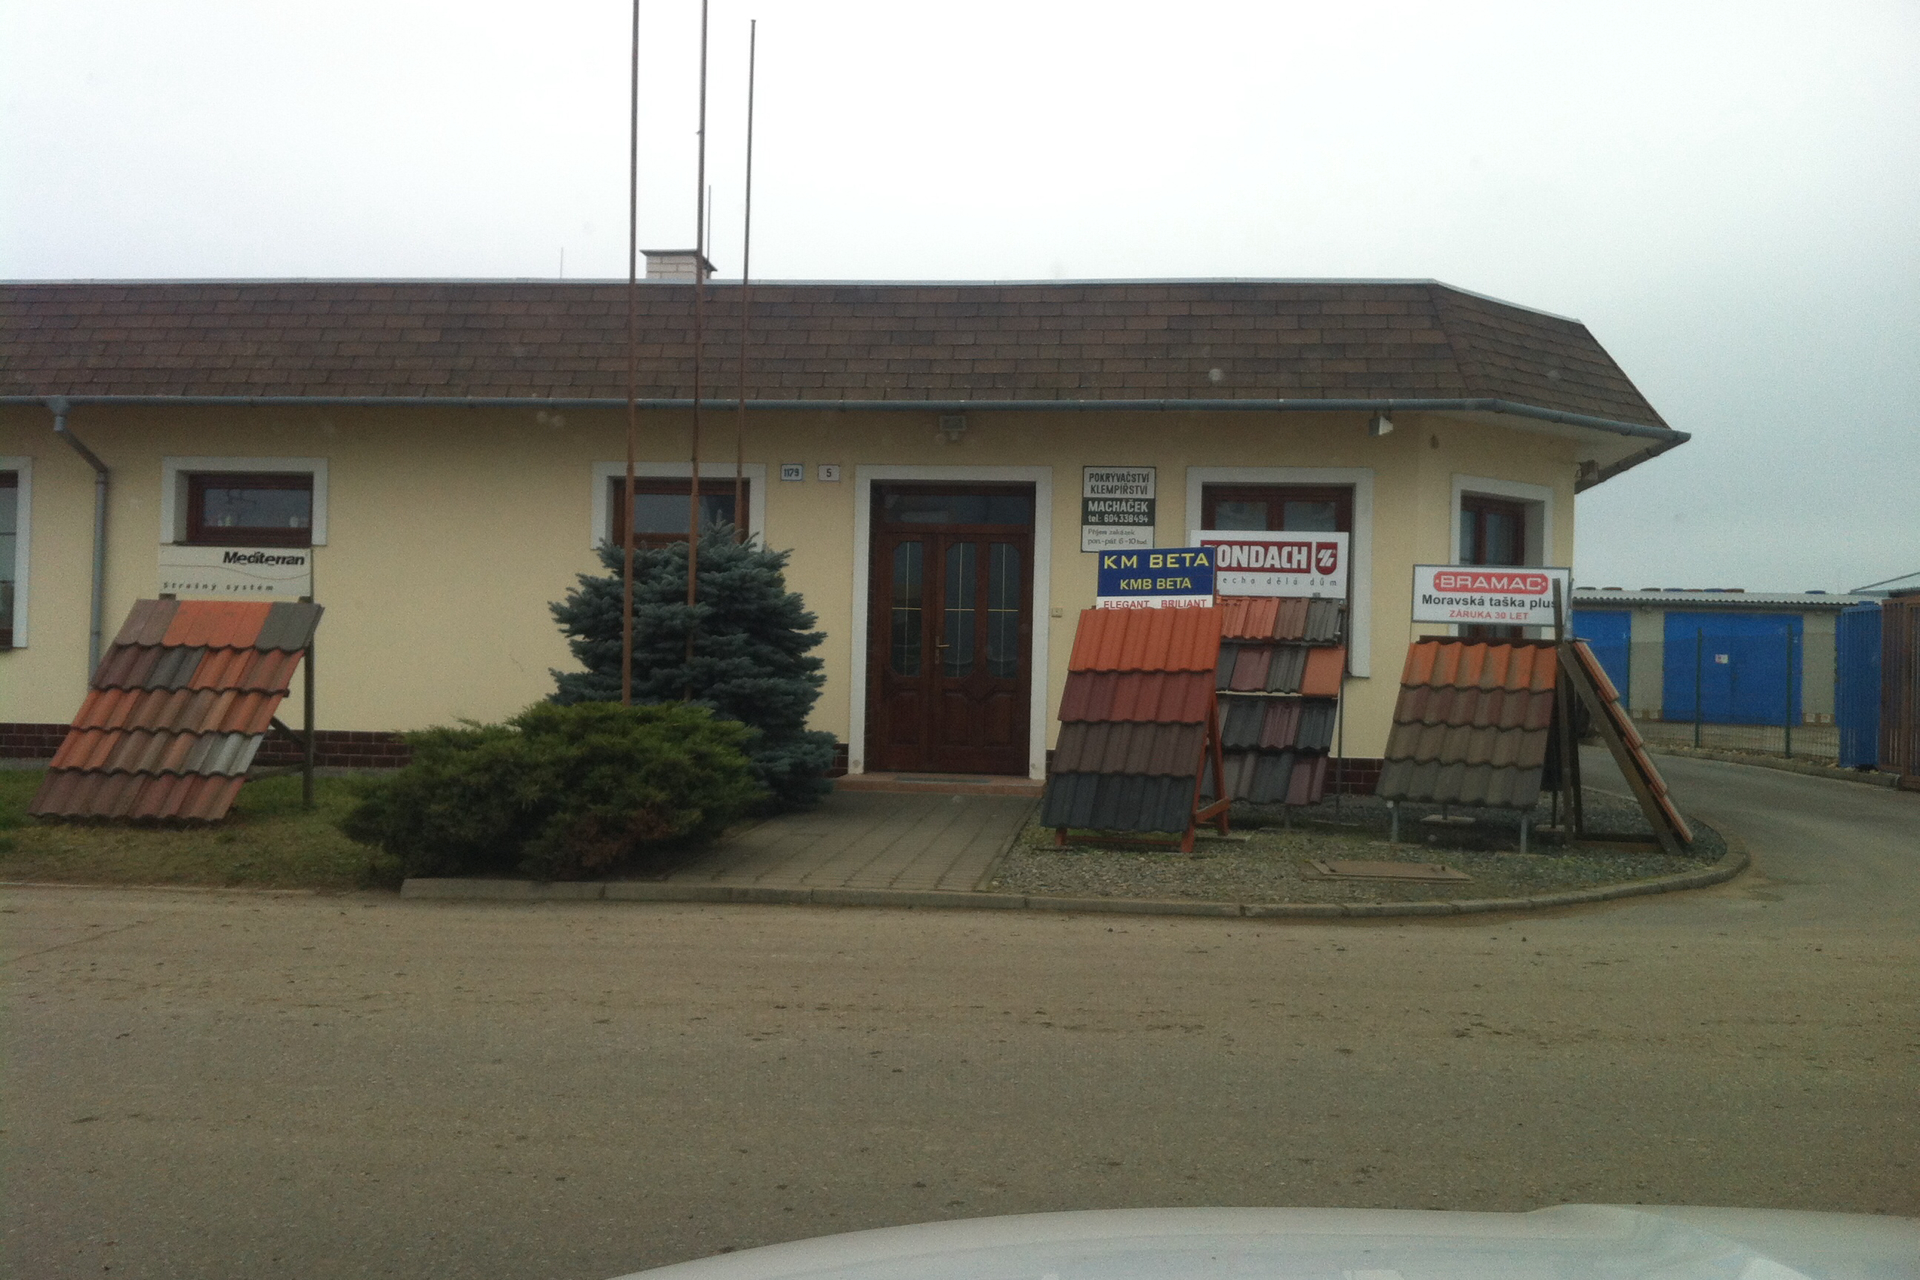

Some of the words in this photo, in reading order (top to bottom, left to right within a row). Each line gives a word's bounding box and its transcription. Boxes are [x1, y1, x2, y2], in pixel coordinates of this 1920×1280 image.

[784, 467, 799, 477] 1179
[826, 467, 832, 478] 5
[1088, 499, 1149, 512] MACHÁČEK
[223, 551, 305, 566] Mediterran
[1104, 555, 1138, 569] KM
[1149, 553, 1210, 568] BETA
[1203, 544, 1308, 569] ONDACH
[1120, 578, 1152, 590] KMB
[1156, 577, 1192, 589] BETA
[1267, 577, 1298, 585] dělá
[1310, 578, 1337, 586] dům
[1440, 575, 1542, 591] BRAMAC
[1104, 600, 1150, 608] ELEGANT
[1161, 599, 1207, 608] BRILIANT
[1422, 594, 1485, 606] Moravská
[1489, 596, 1525, 608] taška
[1449, 609, 1492, 619] ZÁRUKA
[1494, 611, 1507, 619] 30
[1510, 612, 1529, 620] LET
